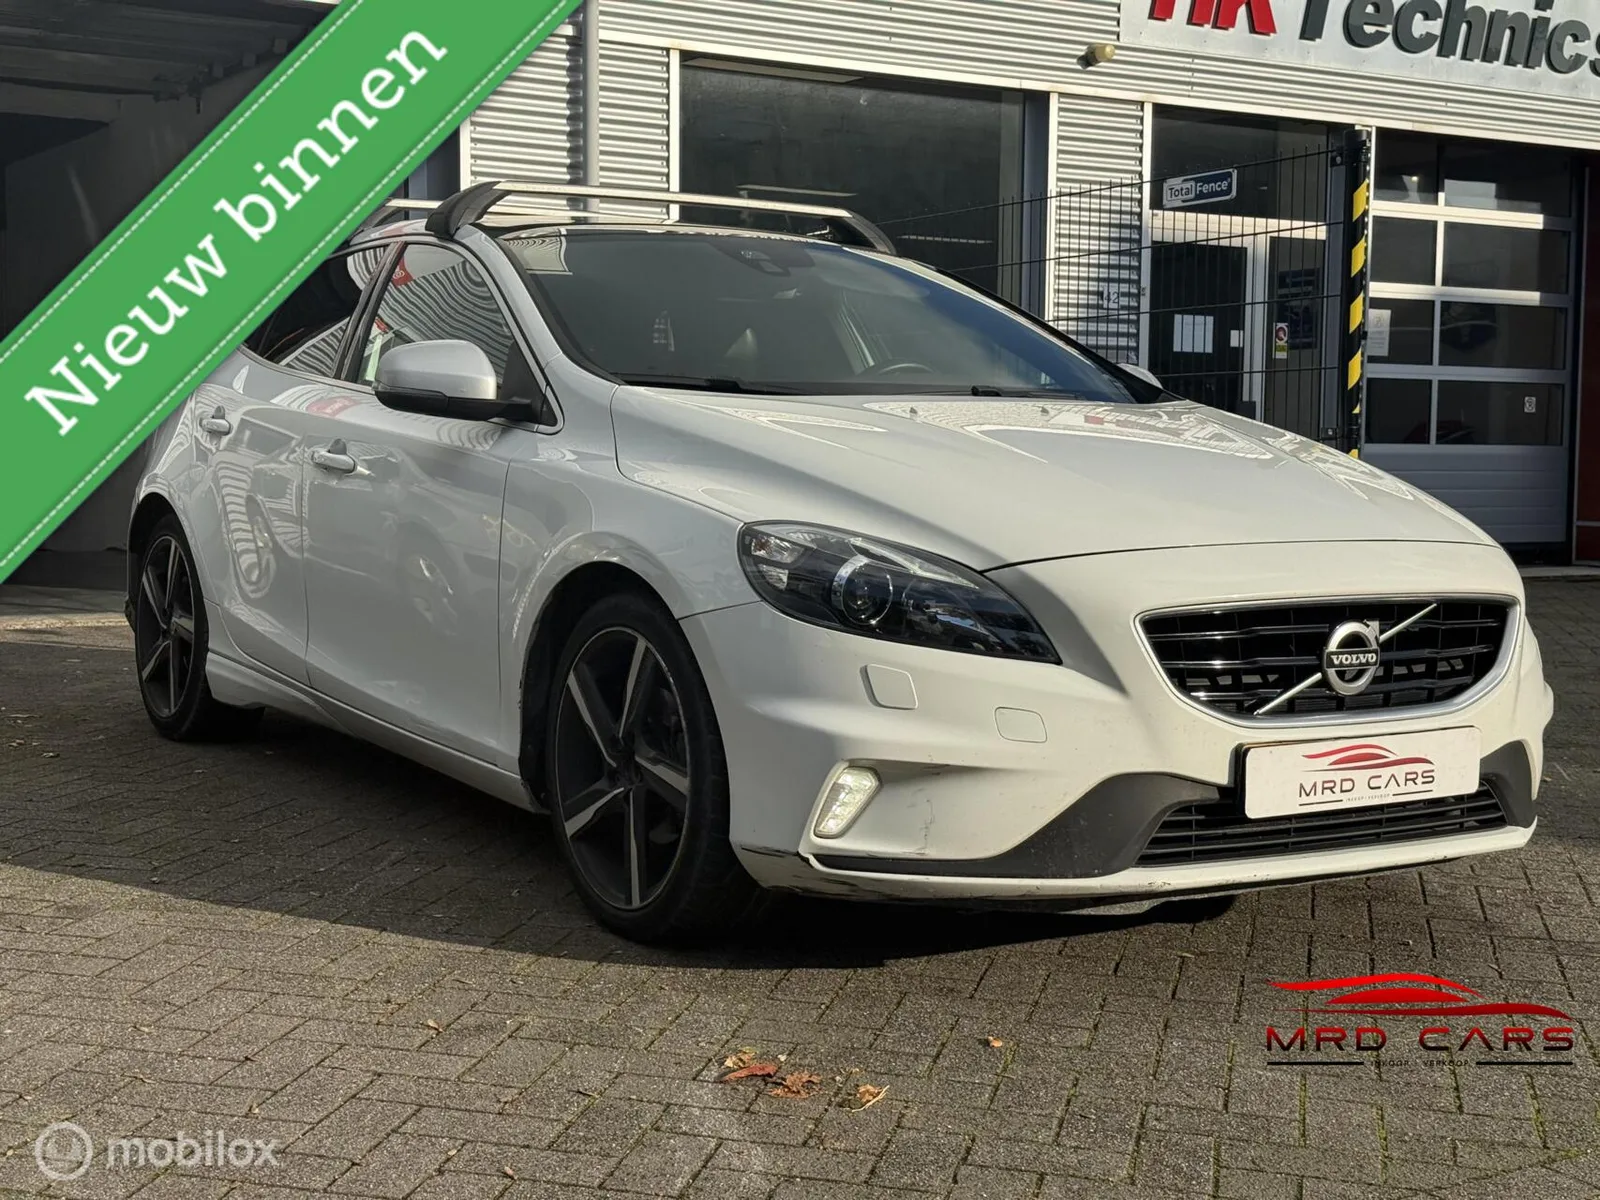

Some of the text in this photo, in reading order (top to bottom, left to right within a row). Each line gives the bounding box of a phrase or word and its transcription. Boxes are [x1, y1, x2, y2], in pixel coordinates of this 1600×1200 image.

[1168, 180, 1229, 198] Total Fence
[1330, 653, 1377, 665] VOLVO
[1298, 778, 1355, 798] MRD
[1367, 769, 1435, 790] CARS
